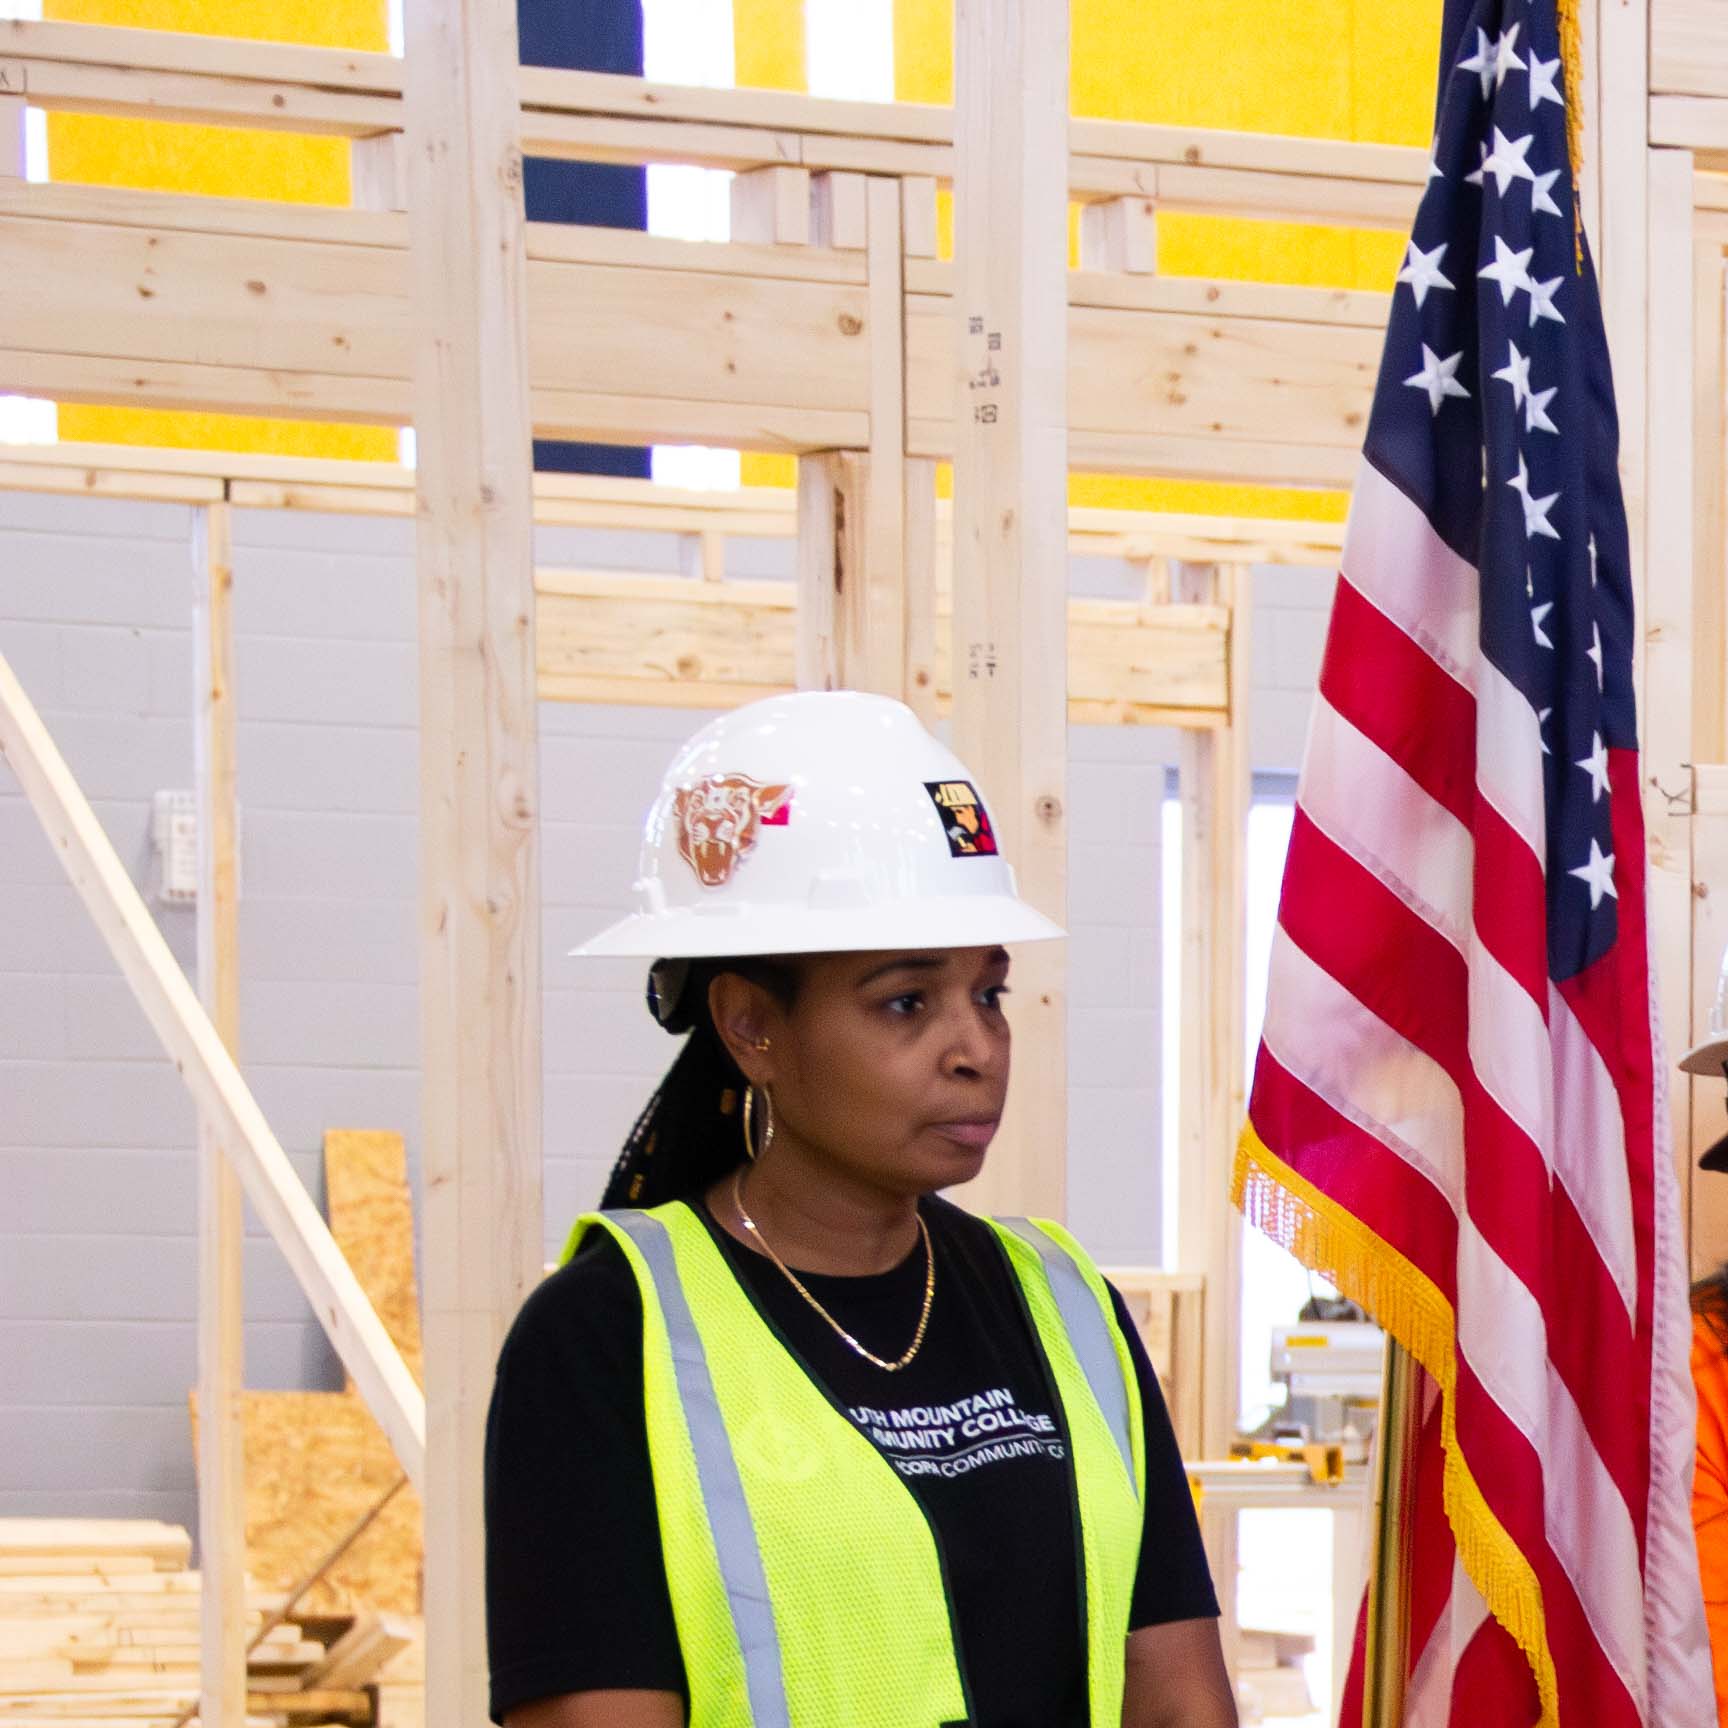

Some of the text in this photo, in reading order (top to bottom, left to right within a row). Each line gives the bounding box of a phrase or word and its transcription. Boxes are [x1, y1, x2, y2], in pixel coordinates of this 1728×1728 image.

[849, 1388, 1015, 1428] UTH MOUNTAIN
[871, 1408, 1056, 1450] MUNITY COLLGE
[941, 1439, 1046, 1478] COMMUNIT
